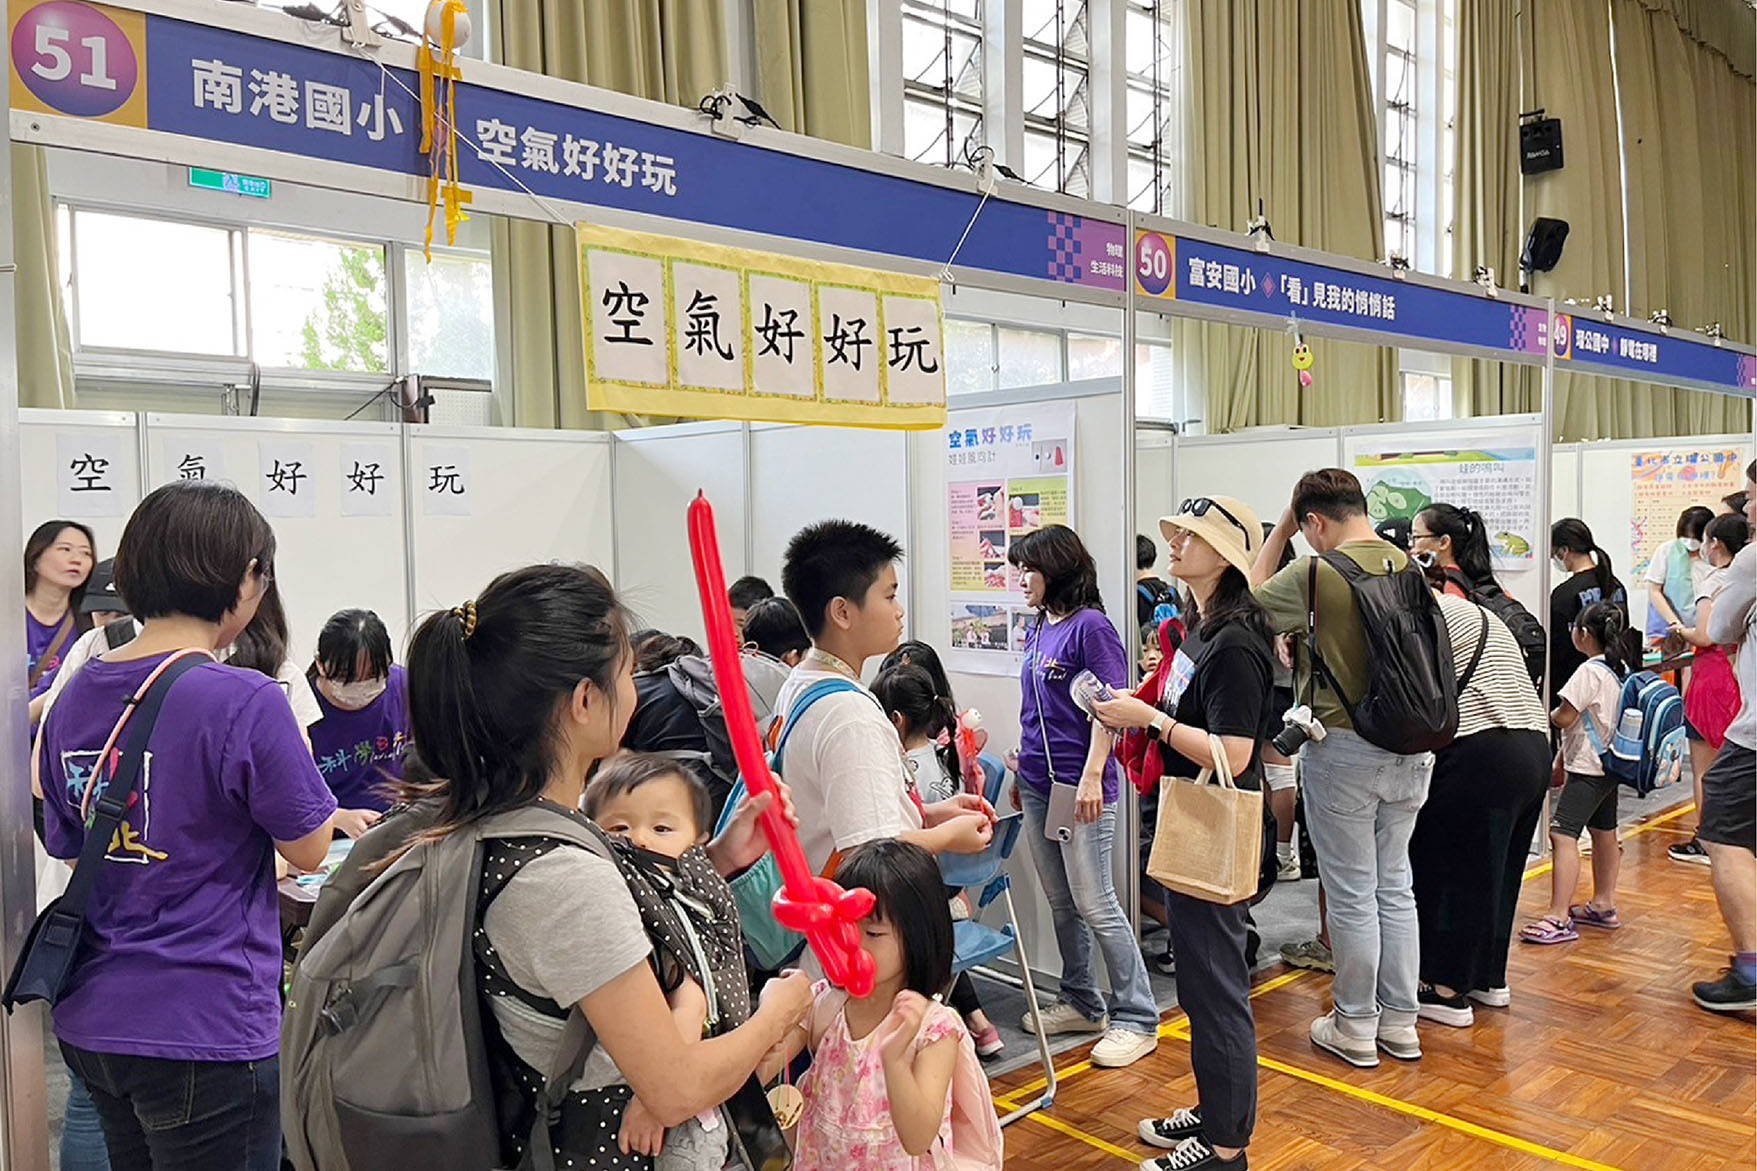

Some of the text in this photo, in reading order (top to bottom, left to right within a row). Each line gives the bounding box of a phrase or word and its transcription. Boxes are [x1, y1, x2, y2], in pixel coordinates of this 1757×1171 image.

[31, 24, 678, 197] 51 南港國小 空氣好好玩
[1106, 241, 1124, 259] 物理
[1090, 260, 1124, 278] 生活科技
[1139, 245, 1396, 321] 50 富安國小 「看」見我的悄悄話
[601, 280, 940, 375] 空氣好好玩
[1553, 318, 1567, 346] 49
[948, 423, 1032, 449] 空氣好好玩
